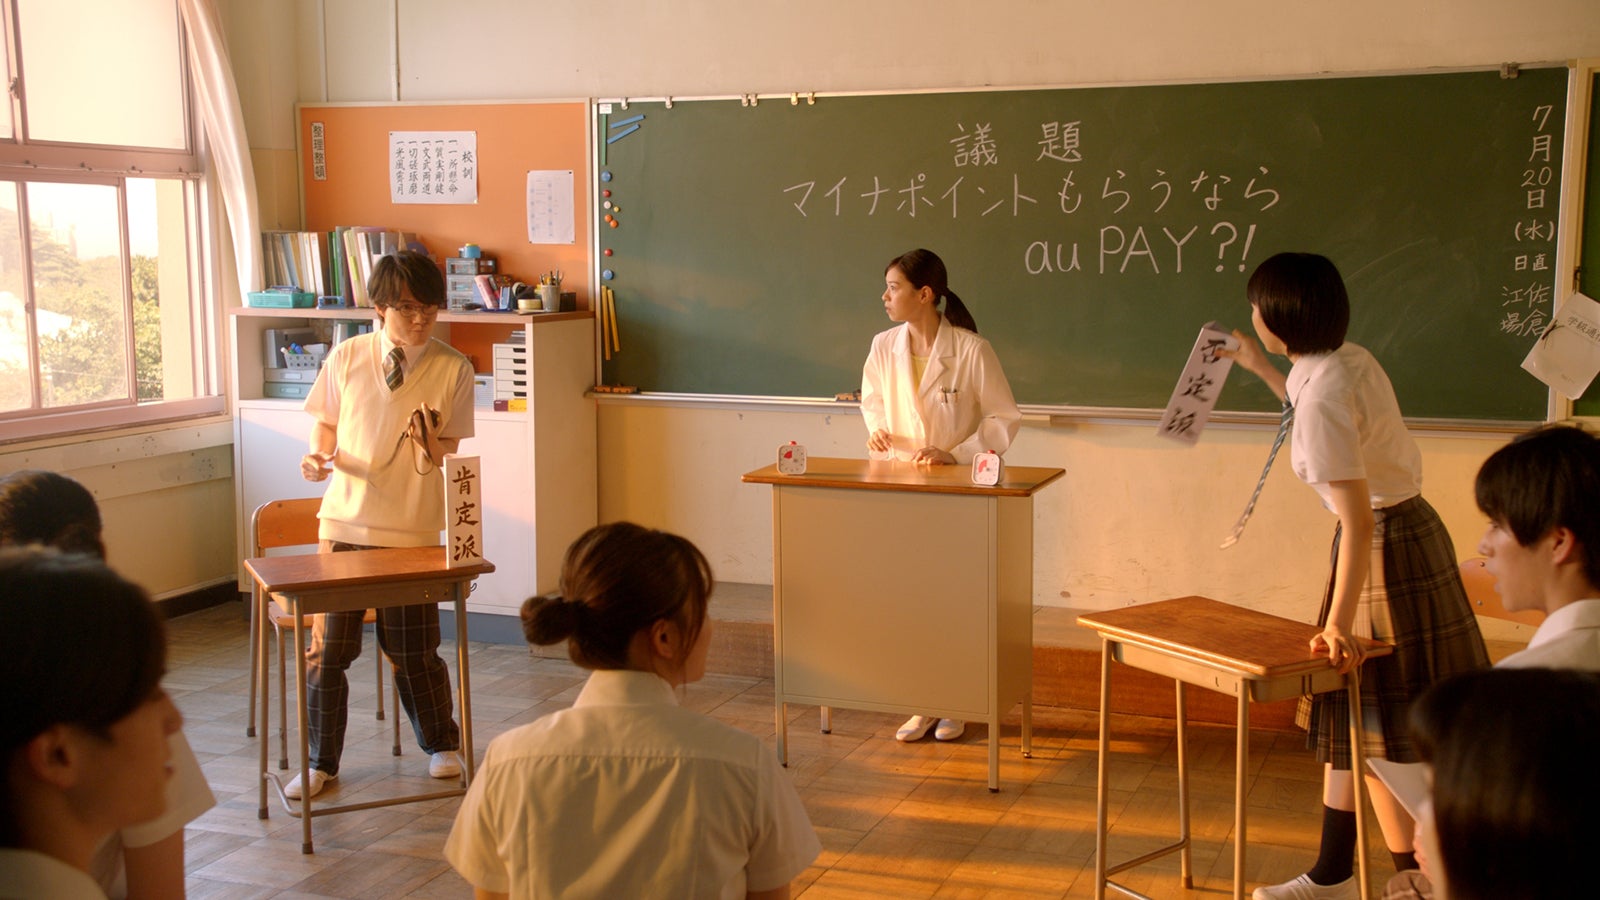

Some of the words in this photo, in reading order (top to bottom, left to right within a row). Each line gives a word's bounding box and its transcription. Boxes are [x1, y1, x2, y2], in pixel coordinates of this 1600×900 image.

[462, 150, 473, 180] 校訓
[783, 166, 1280, 217] マイナポイントもらうなら
[1025, 239, 1081, 275] au
[1514, 253, 1549, 272] 日直
[1523, 280, 1551, 337] 佐倉
[1164, 338, 1227, 436] 否定派
[452, 465, 481, 562] 肯定派
